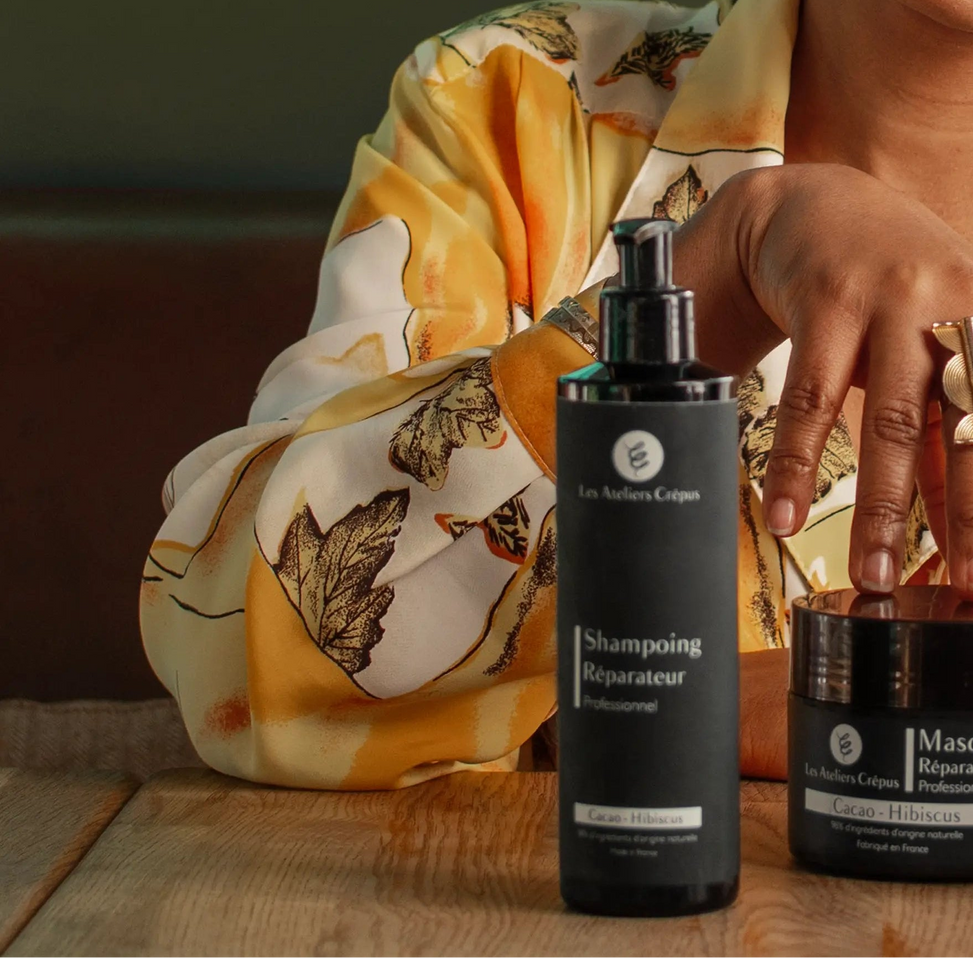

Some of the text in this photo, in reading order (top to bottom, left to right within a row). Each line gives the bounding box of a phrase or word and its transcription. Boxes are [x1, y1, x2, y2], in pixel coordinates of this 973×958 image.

[578, 484, 598, 499] Les
[601, 485, 652, 502] Ateliers
[584, 628, 702, 659] Shampoing
[583, 661, 687, 688] Réparateur
[583, 695, 658, 713] Professionnel
[805, 763, 900, 790] Les Ateliers Crépus
[588, 808, 622, 824] Cacao
[631, 811, 684, 825] Hibiscus
[833, 797, 875, 818] Cacao
[889, 804, 961, 823] Hibiscus
[891, 828, 926, 841] d'origine
[927, 830, 964, 840] naturelle
